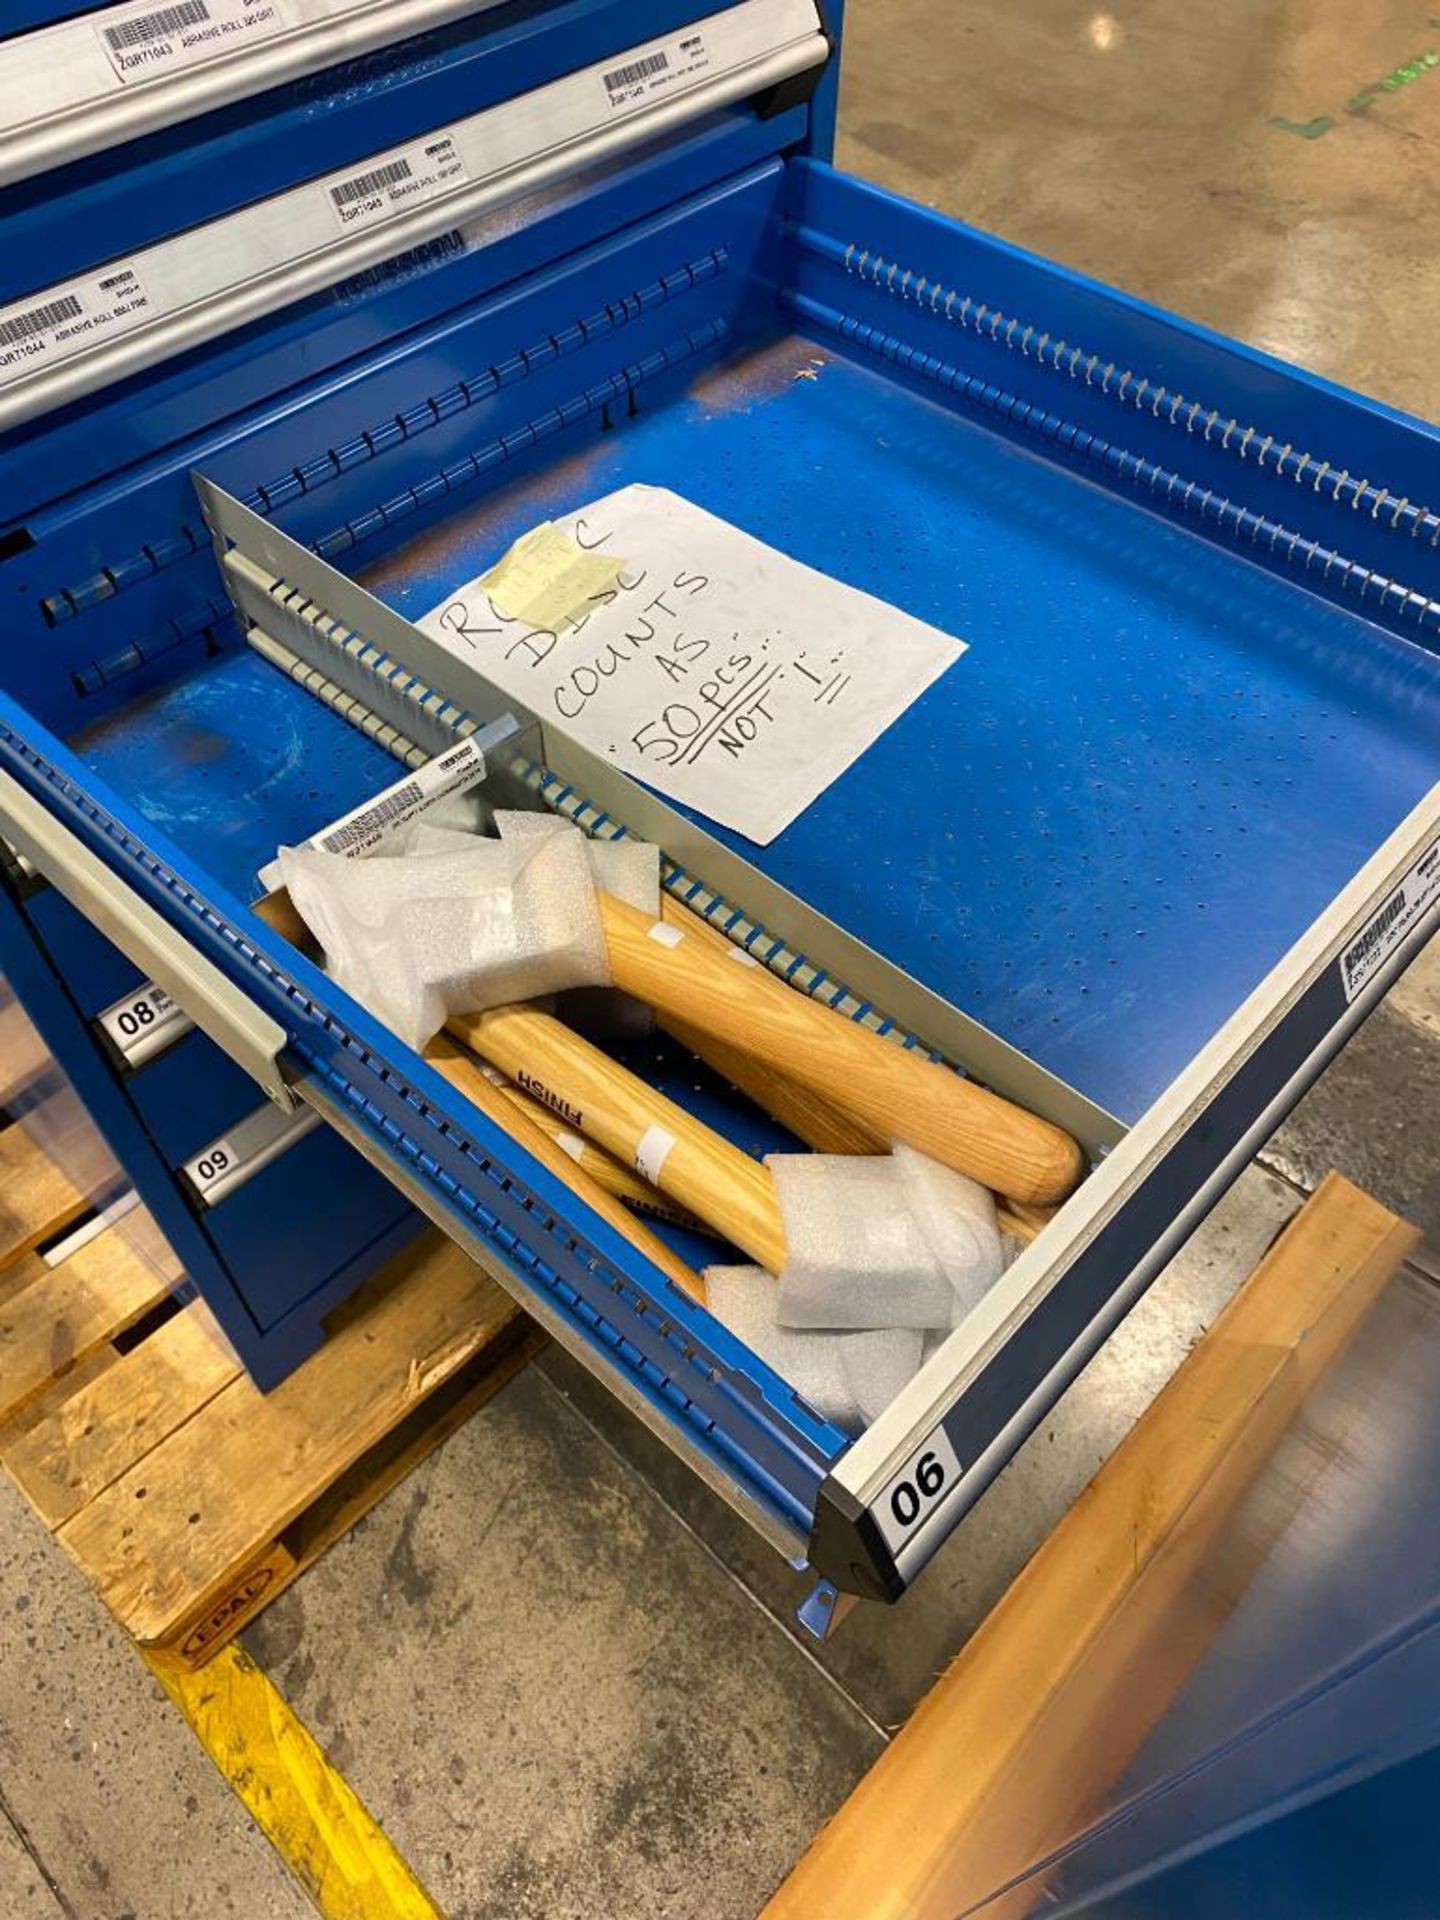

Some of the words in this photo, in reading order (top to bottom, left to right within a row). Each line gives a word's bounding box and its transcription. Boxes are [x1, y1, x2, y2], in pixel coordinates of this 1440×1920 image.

[554, 571, 709, 719] COUNTS
[654, 632, 711, 683] AS
[632, 703, 701, 762] 50
[717, 689, 775, 758] NOT
[117, 1001, 155, 1035] 08
[517, 1069, 584, 1127] FINISH
[198, 1149, 230, 1180] 09
[890, 1451, 945, 1527] 06
[195, 1586, 257, 1642] EPAL
